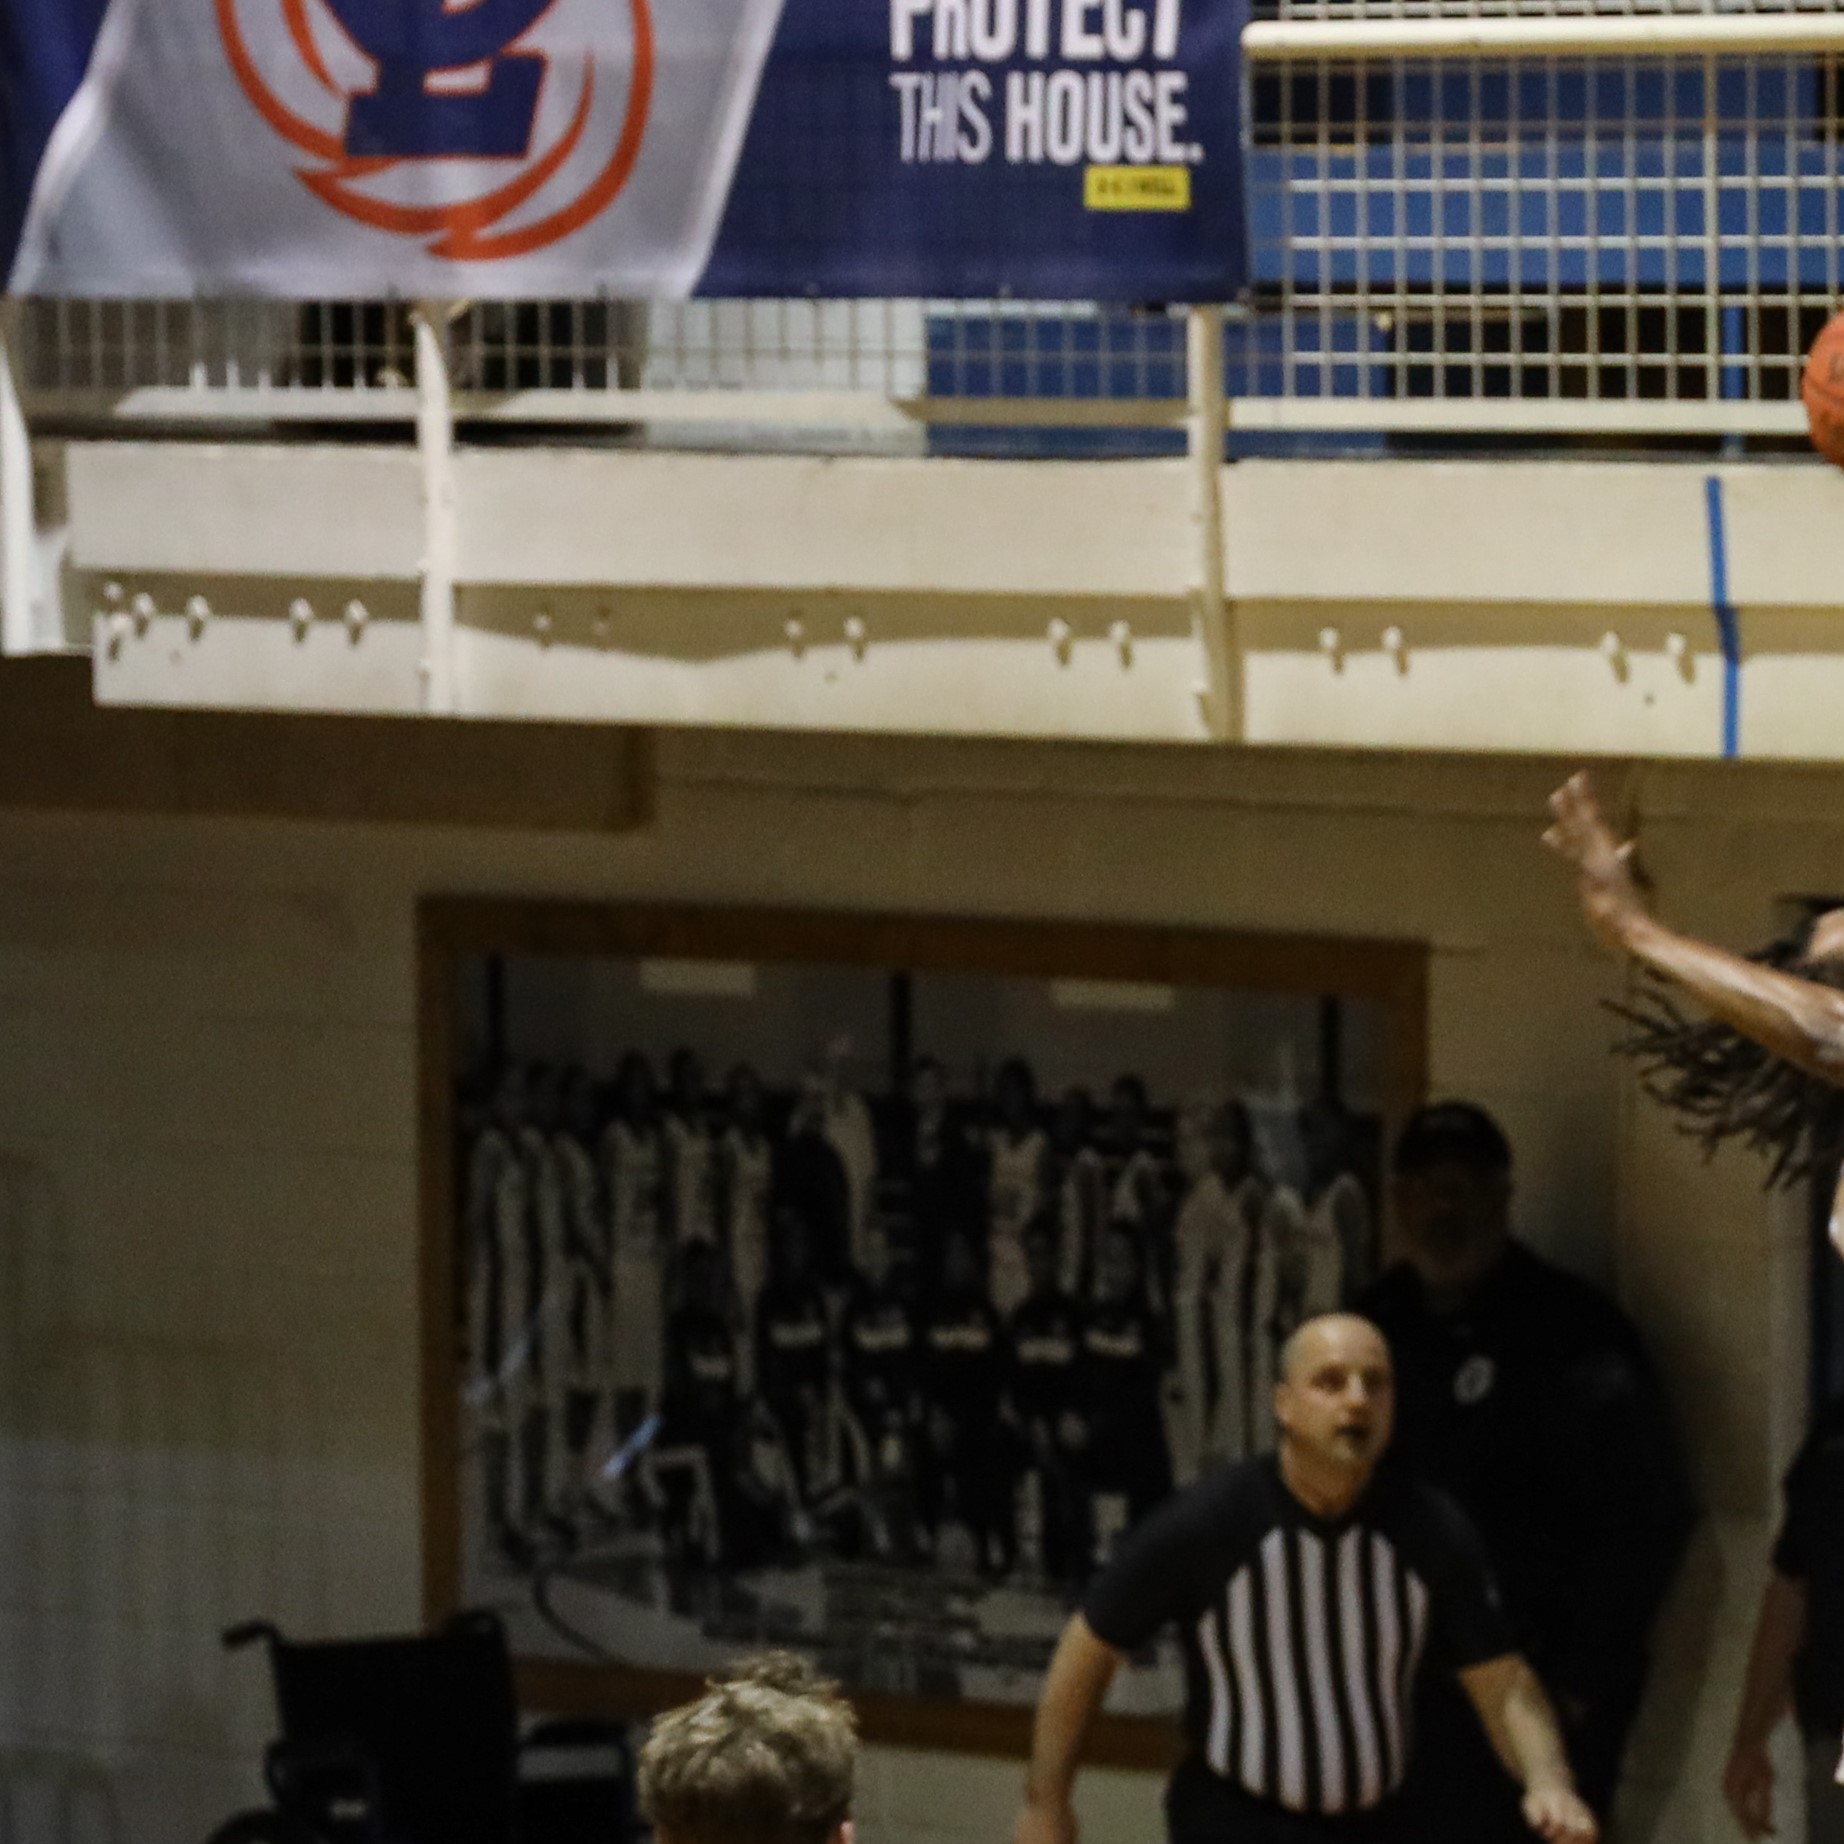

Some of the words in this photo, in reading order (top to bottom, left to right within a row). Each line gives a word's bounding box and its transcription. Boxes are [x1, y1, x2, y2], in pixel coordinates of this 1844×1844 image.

[890, 0, 1180, 61] PROTECT
[889, 70, 993, 164] THIS
[1004, 69, 1203, 165] HOUSE.
